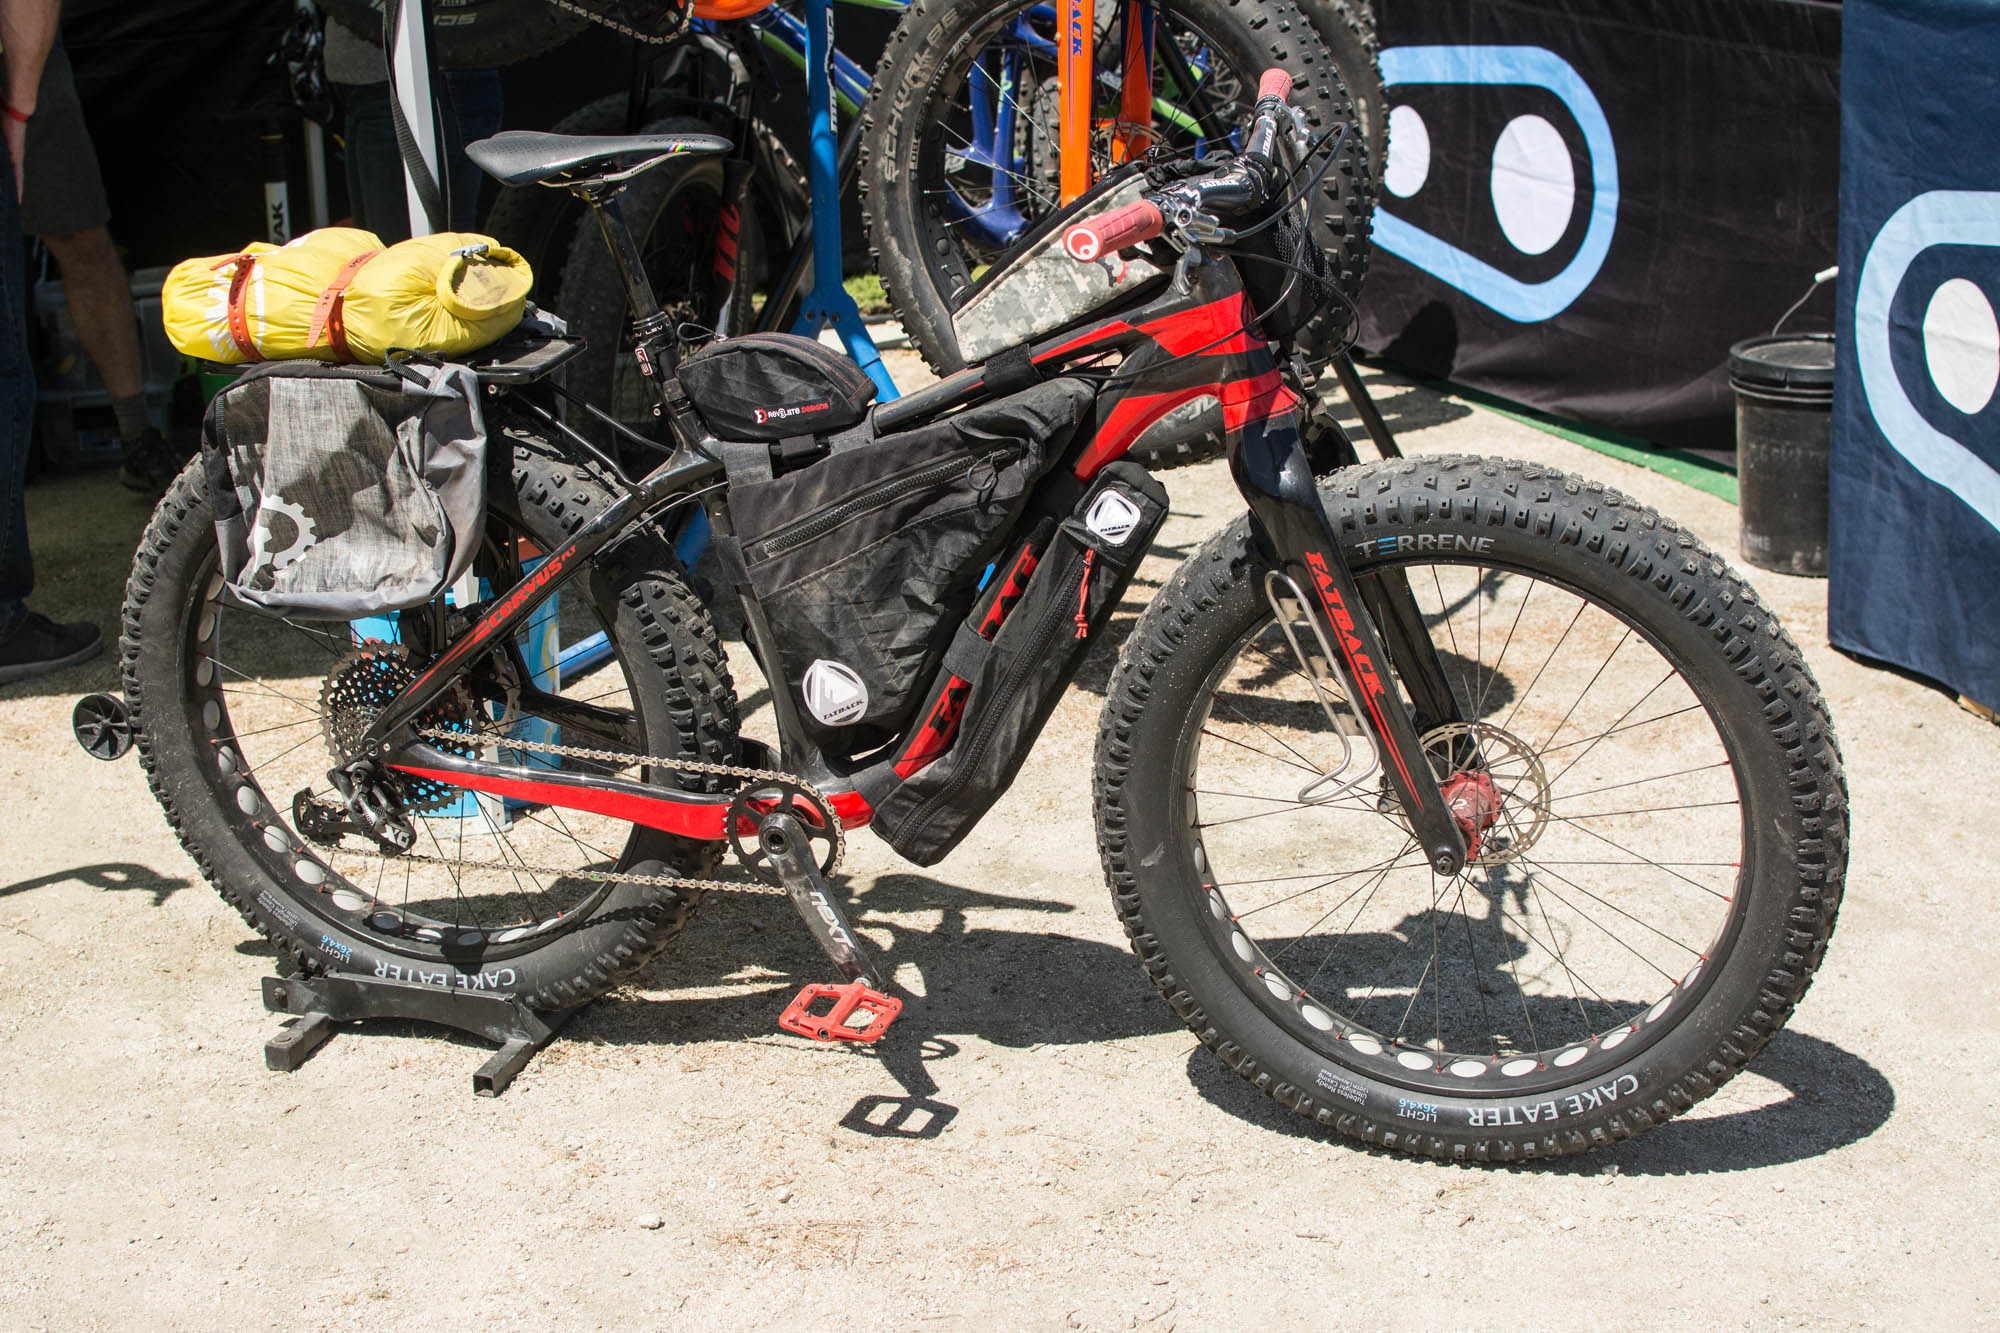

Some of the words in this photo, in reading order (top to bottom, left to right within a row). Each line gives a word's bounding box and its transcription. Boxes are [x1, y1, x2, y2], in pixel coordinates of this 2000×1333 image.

[884, 7, 959, 183] SCHWALBE
[272, 201, 286, 240] AK
[1354, 533, 1496, 558] TERRENE
[488, 556, 563, 628] CORVUS
[1305, 551, 1385, 698] FATBACK
[823, 699, 865, 720] FATBACK
[320, 943, 351, 964] LIGHT
[321, 935, 353, 957] 26x4.6
[455, 968, 517, 990] CAKE
[1315, 1078, 1337, 1094] Ready
[1336, 1088, 1366, 1106] Tubeless
[1565, 1073, 1640, 1115] CAKE
[1397, 1107, 1437, 1123] LIGHT
[1399, 1098, 1438, 1114] 26x4.6
[1465, 1100, 1560, 1127] EATER
